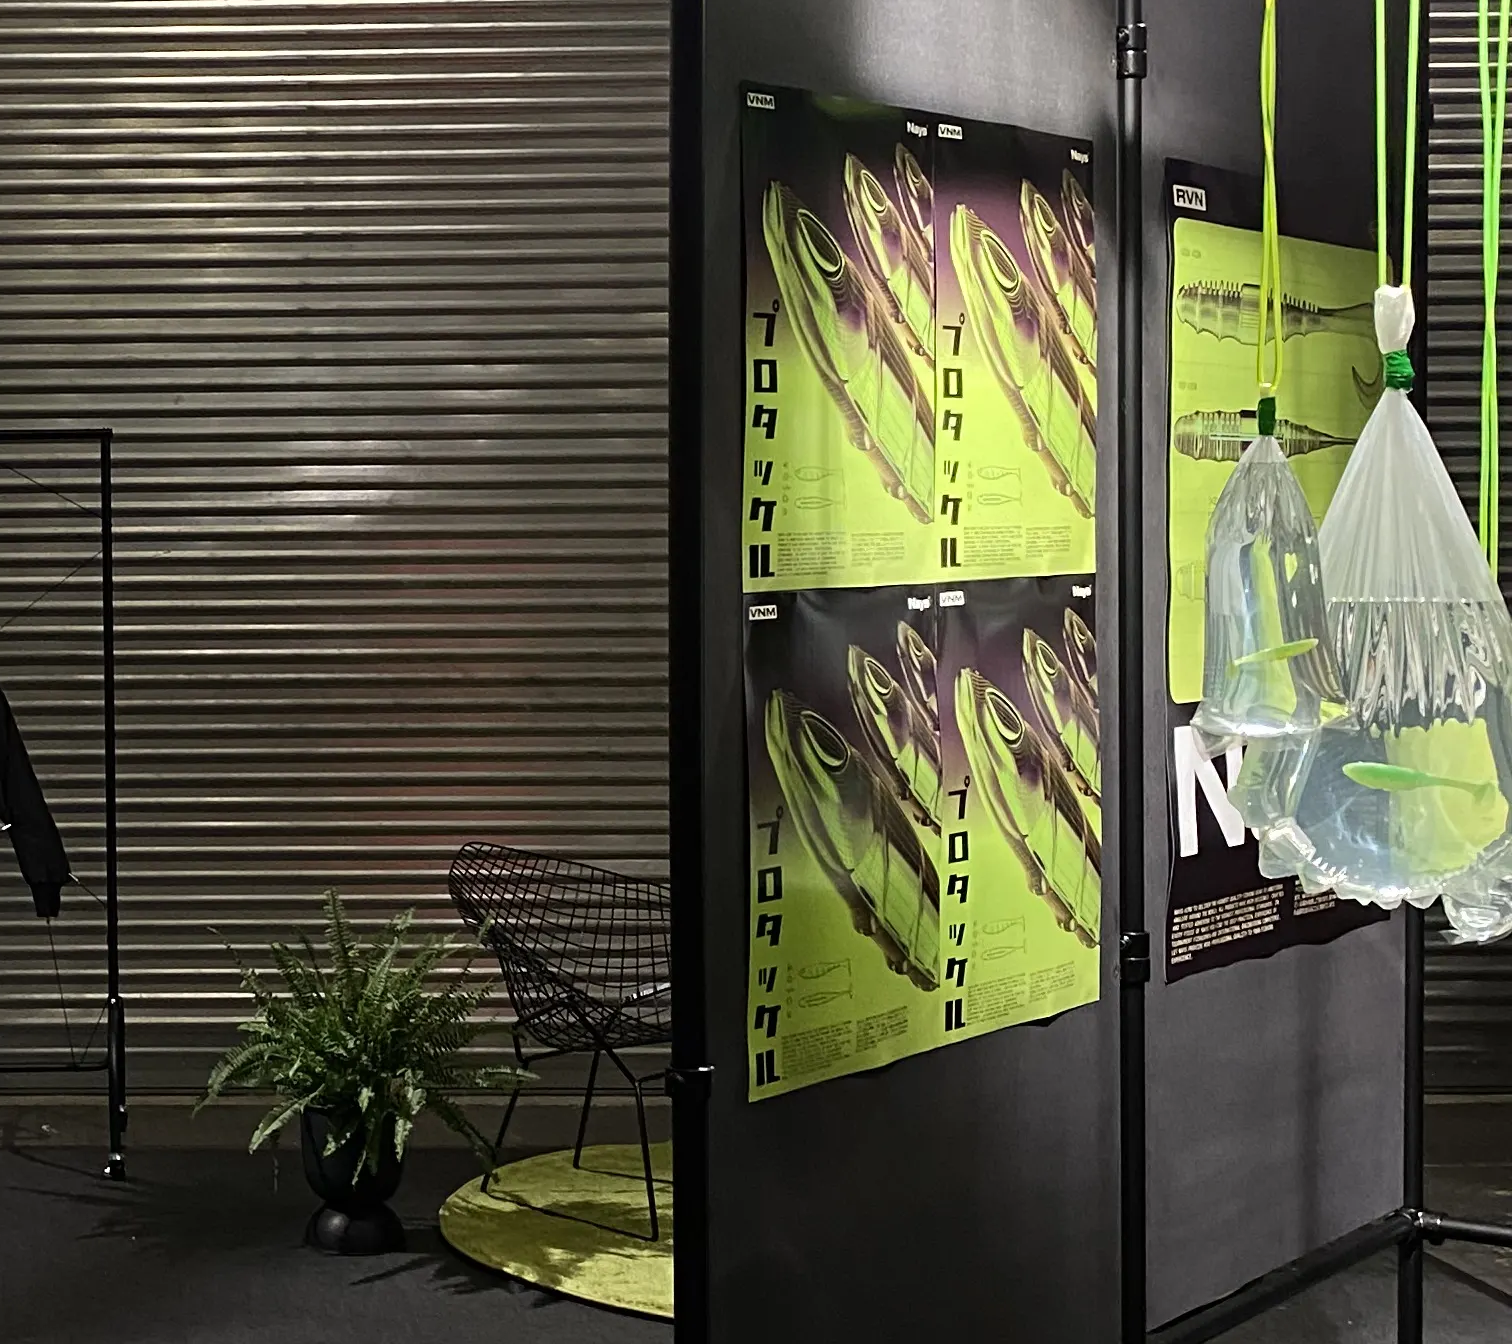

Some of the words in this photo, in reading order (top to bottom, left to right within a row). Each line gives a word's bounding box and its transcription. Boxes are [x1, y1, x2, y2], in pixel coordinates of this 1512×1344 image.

[748, 94, 774, 108] VNM
[1176, 189, 1204, 207] RVN
[749, 606, 776, 619] VNM
